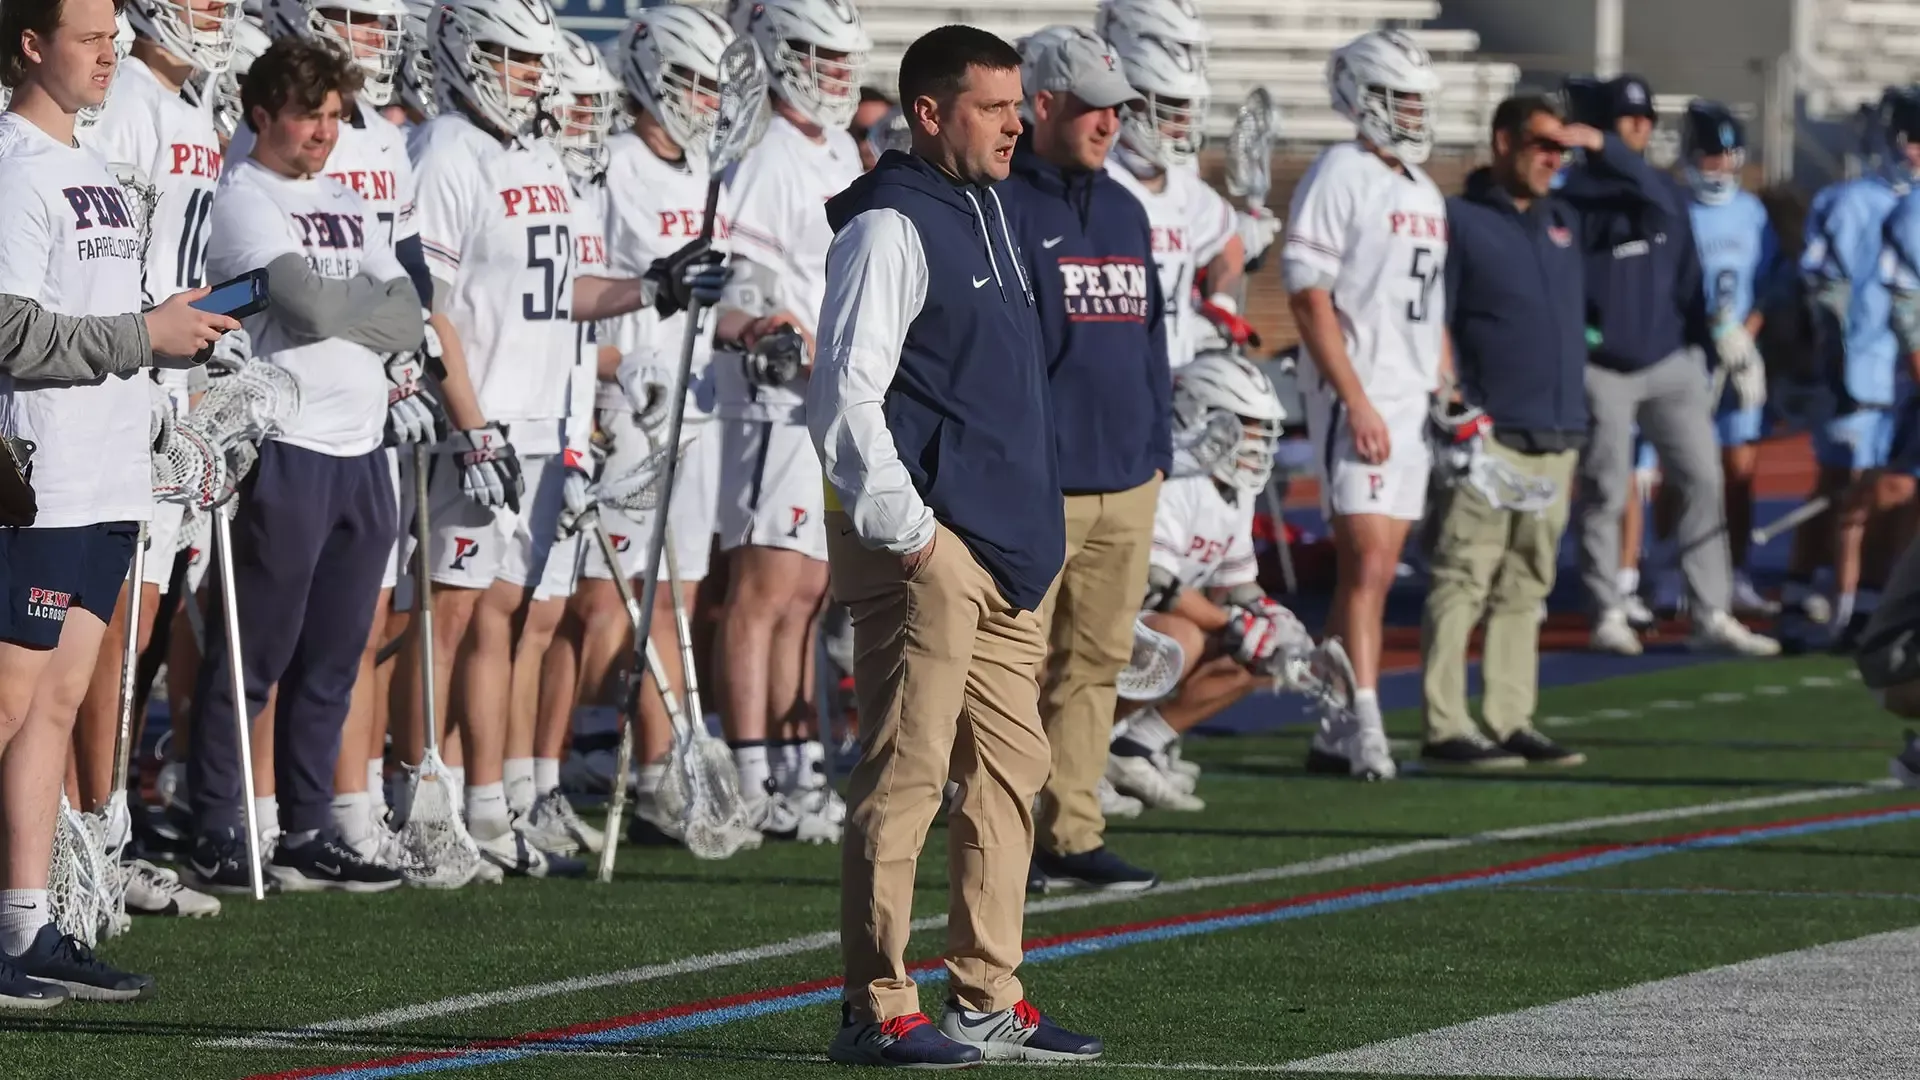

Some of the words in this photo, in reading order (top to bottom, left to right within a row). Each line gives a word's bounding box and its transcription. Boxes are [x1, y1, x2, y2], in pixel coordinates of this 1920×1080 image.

[523, 224, 570, 321] 52
[1059, 263, 1147, 298] PENN
[786, 506, 808, 538] P
[450, 536, 479, 570] P
[29, 587, 71, 608] PENN
